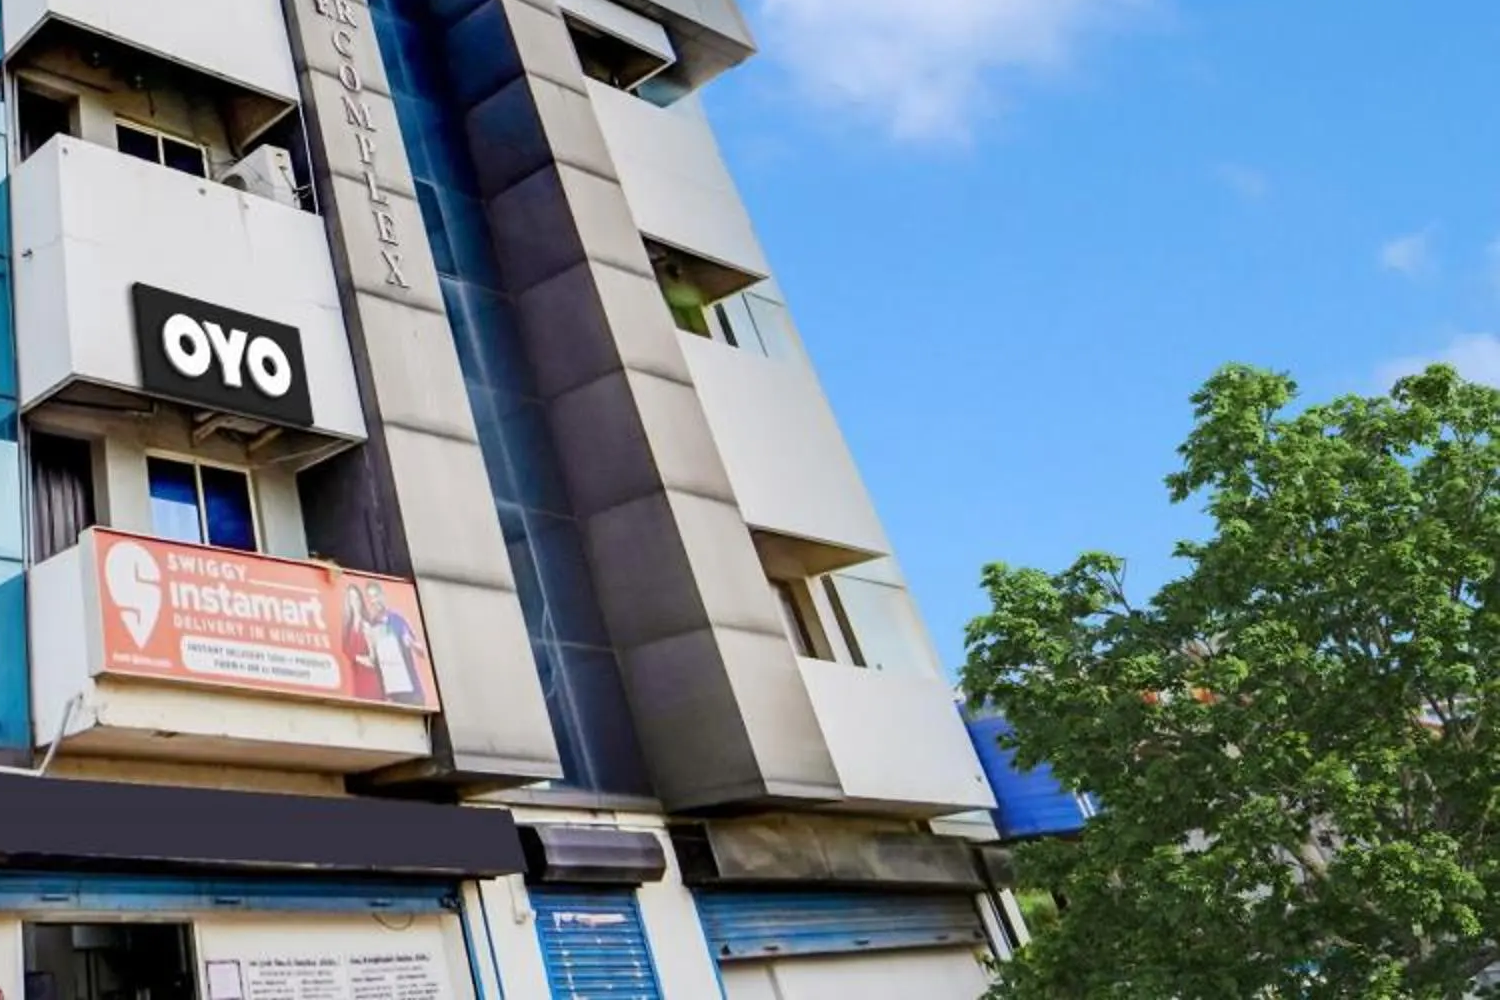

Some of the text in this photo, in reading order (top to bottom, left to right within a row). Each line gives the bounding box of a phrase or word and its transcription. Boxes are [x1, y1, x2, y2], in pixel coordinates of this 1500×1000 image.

[332, 29, 410, 289] COMPLEX
[162, 312, 292, 398] OYO
[167, 552, 248, 582] SWIGGY
[173, 613, 331, 649] DELIVERY IN MINUTES
